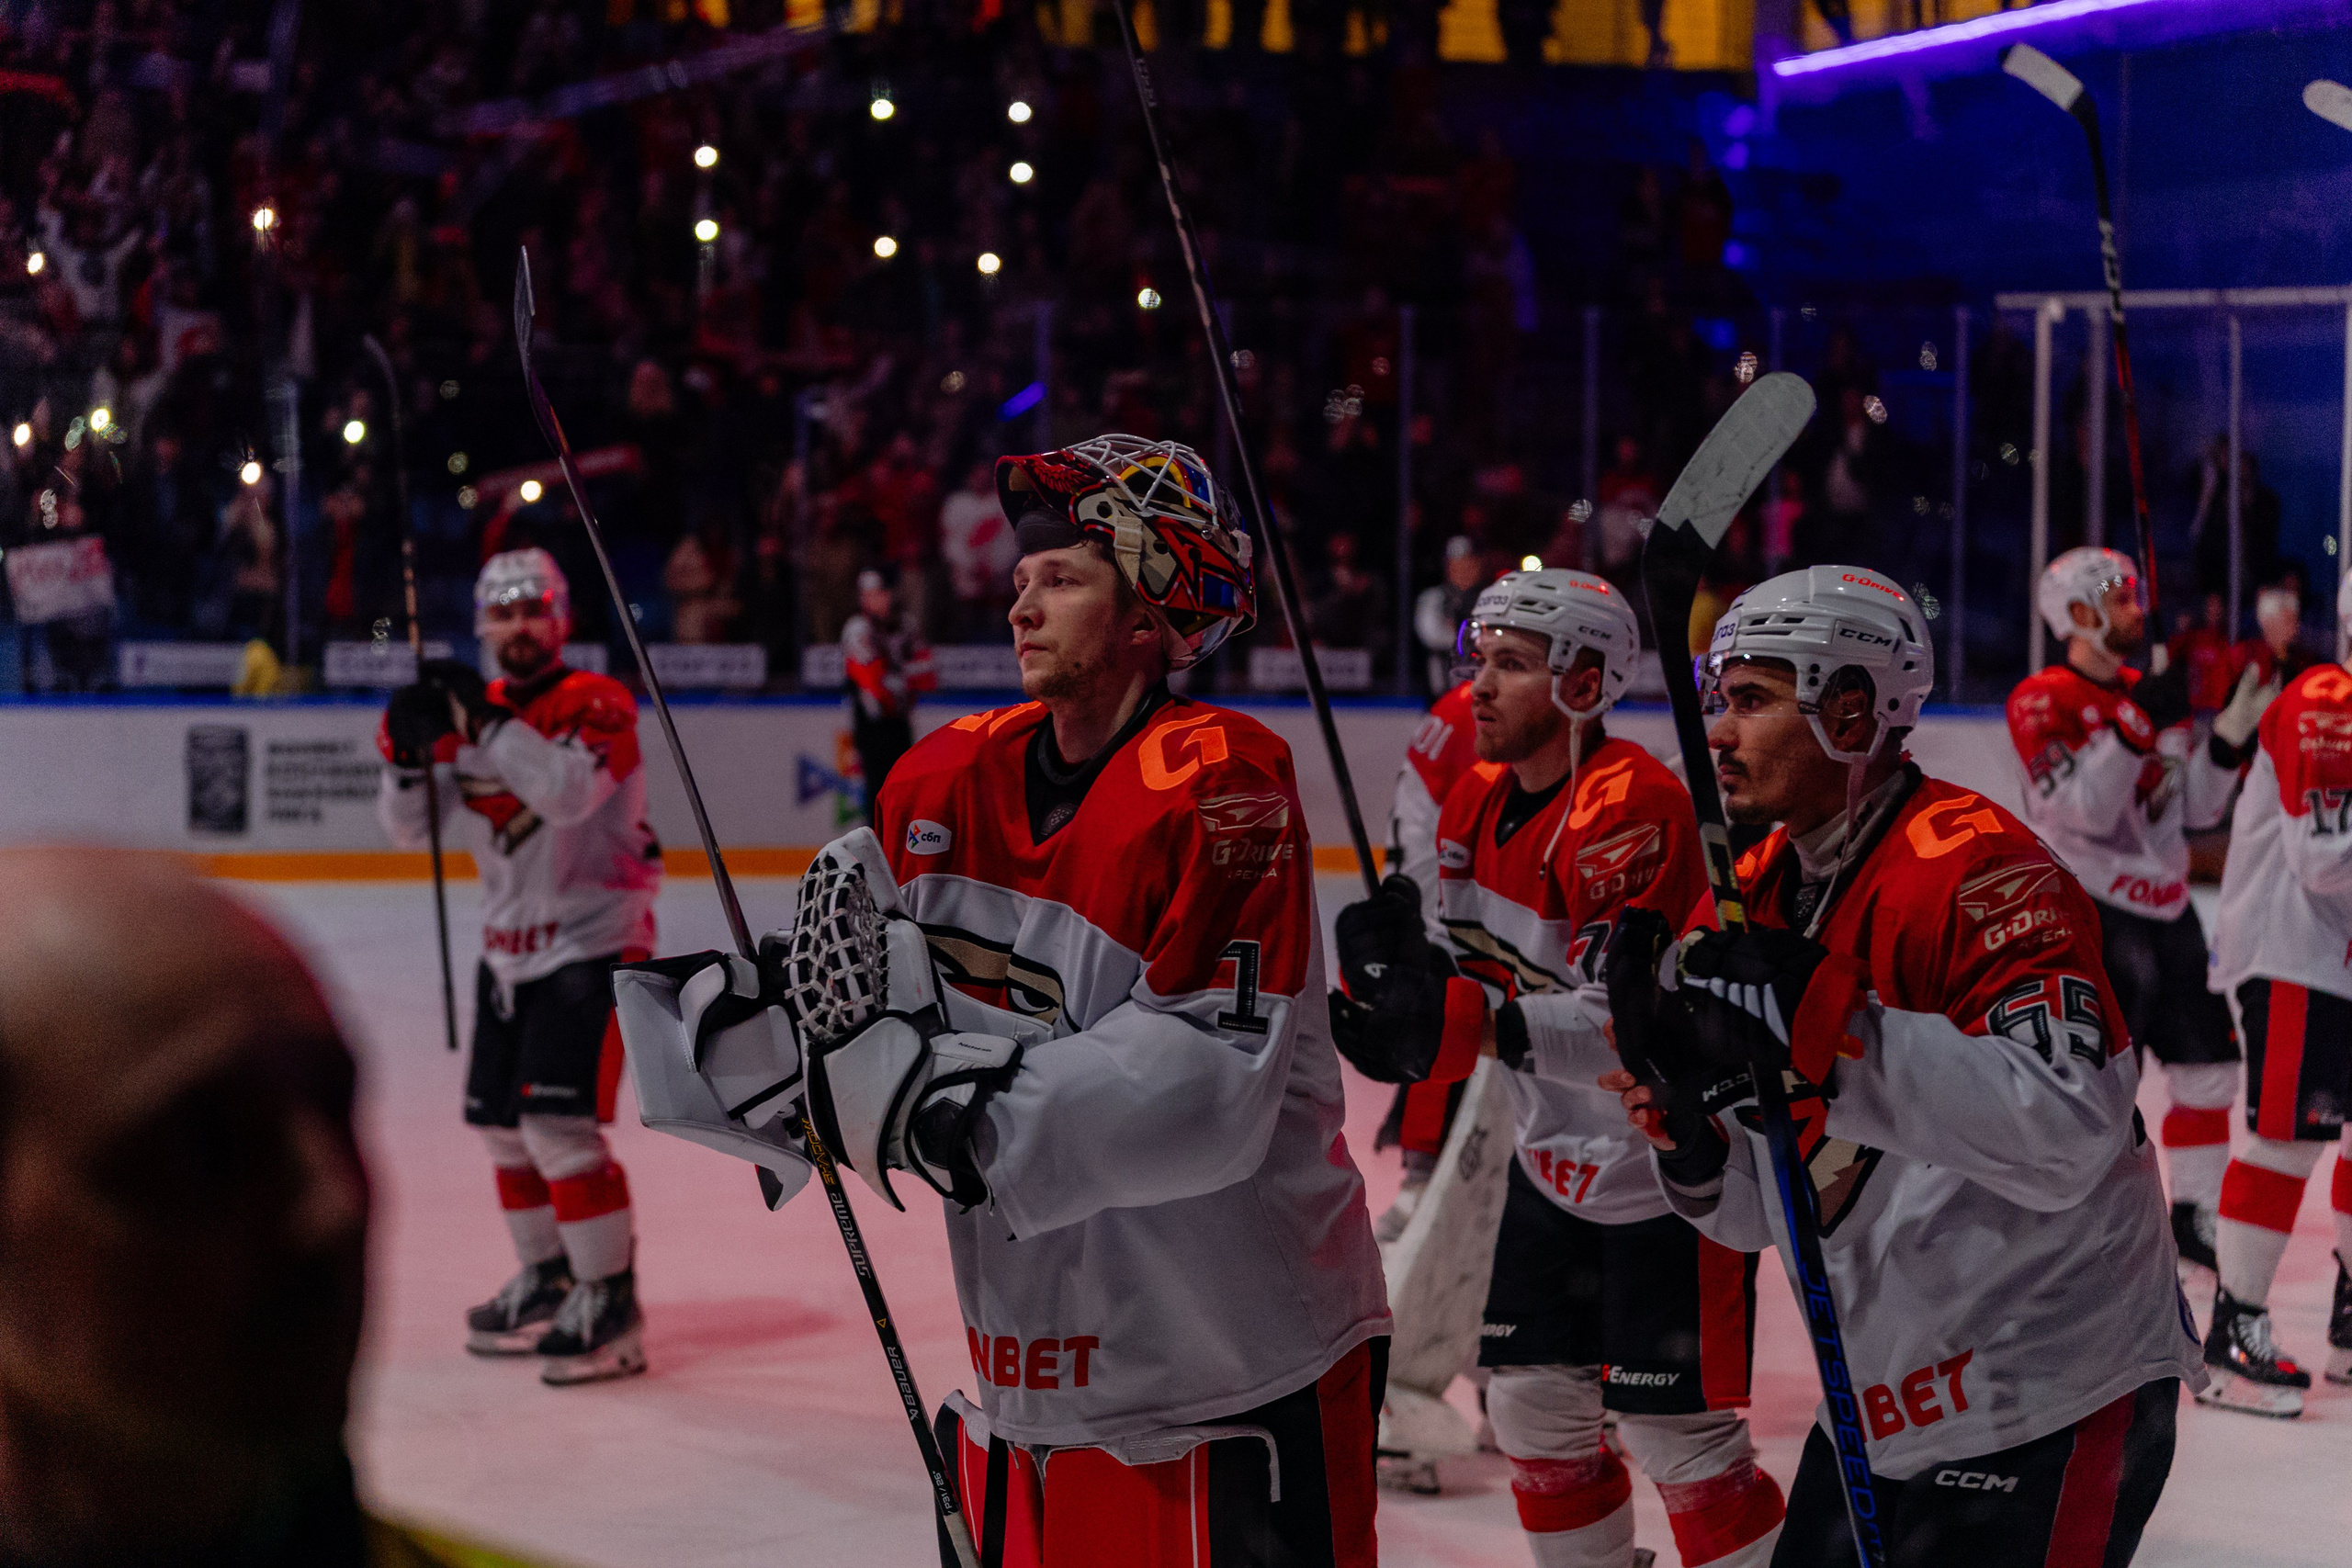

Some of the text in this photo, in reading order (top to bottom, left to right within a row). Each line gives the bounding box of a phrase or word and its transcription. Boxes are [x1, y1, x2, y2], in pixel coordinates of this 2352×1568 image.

[1578, 626, 1611, 639] CCM
[1839, 627, 1894, 647] CCM
[922, 832, 942, 843] сбп
[2301, 787, 2352, 837] 17
[1216, 939, 1269, 1035] 1
[1984, 974, 2107, 1071] 55
[1702, 1072, 1751, 1102] CCM
[830, 1192, 871, 1279] SUPREME
[887, 1346, 915, 1407] BAUER
[967, 1325, 1100, 1391] NBET
[1800, 1260, 1877, 1519] JETSPEED
[1854, 1347, 1973, 1443] BET
[1935, 1470, 2019, 1493] CCM
